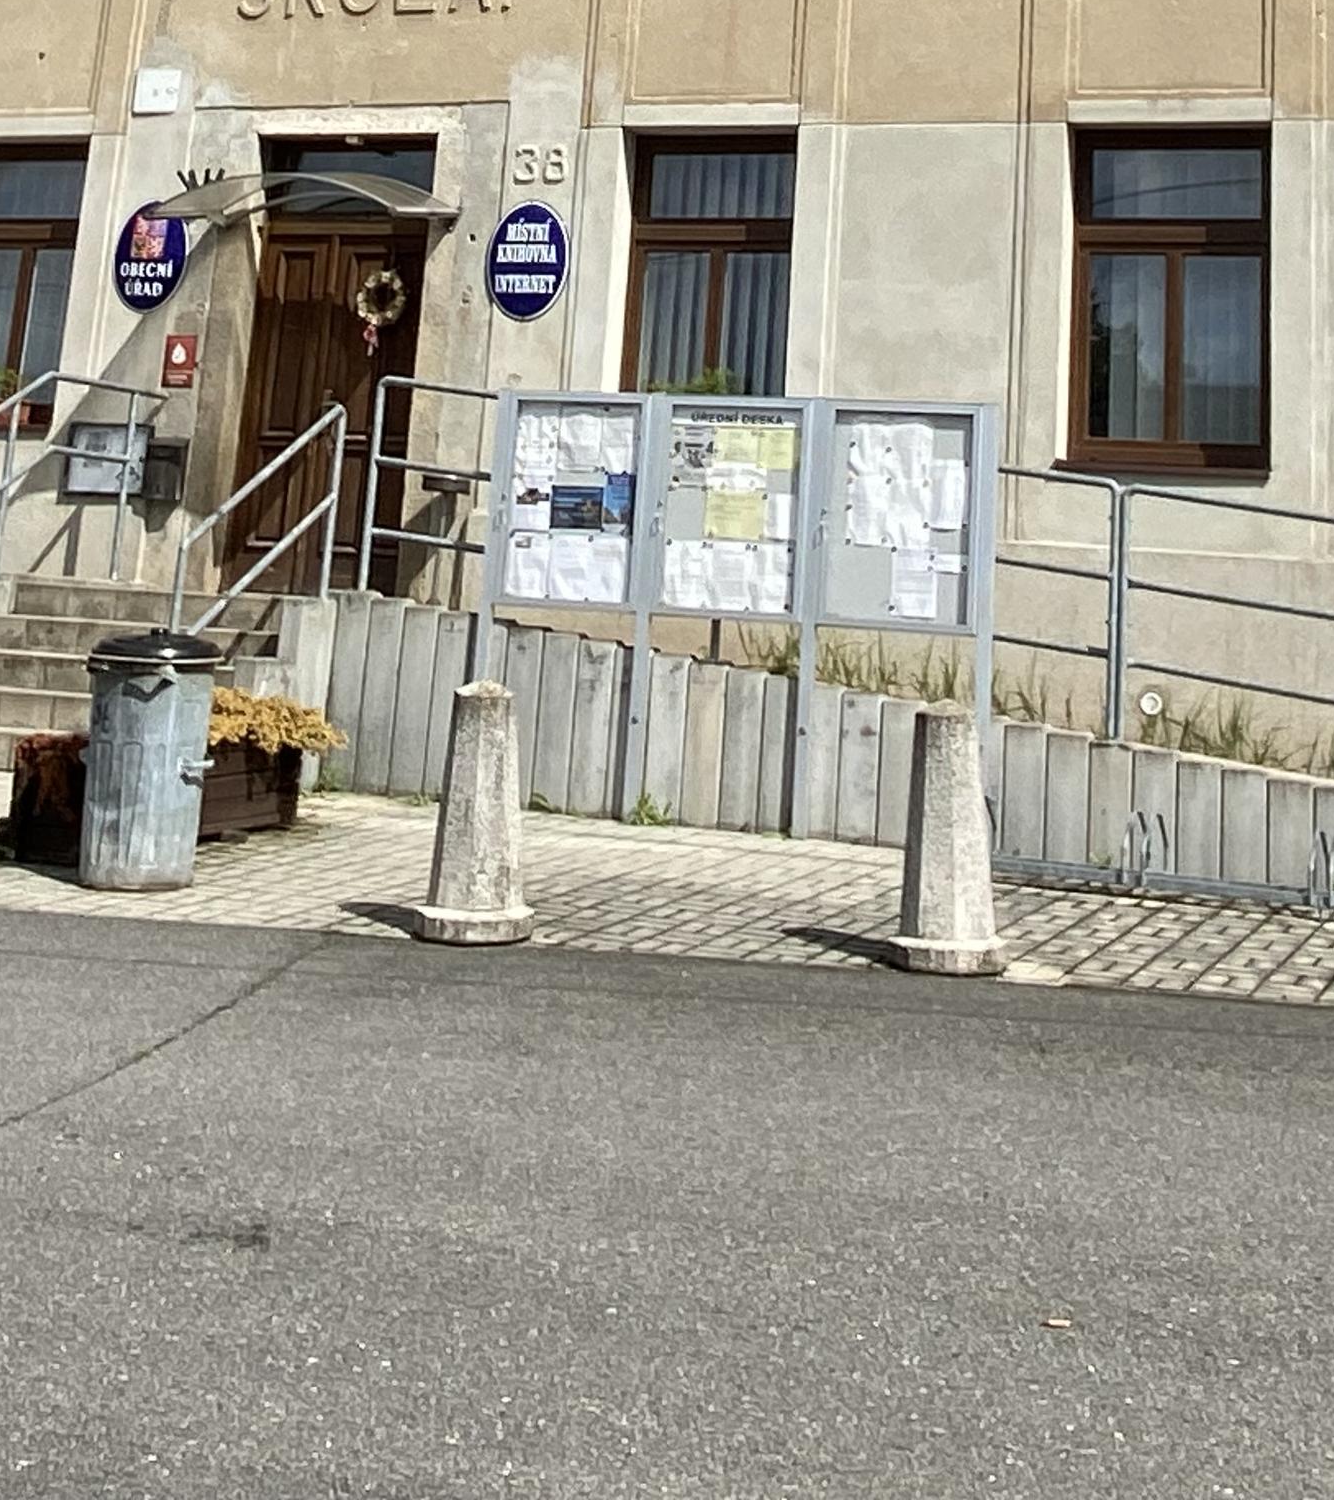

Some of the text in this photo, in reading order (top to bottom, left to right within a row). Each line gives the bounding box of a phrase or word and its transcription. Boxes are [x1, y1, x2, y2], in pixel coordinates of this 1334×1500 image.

[513, 144, 569, 185] 38
[505, 217, 553, 242] MÍSTNÍ
[496, 244, 557, 263] KNIHOVNA
[120, 260, 173, 278] OBECNÍ
[124, 278, 163, 296] ÚŘAD
[494, 274, 557, 293] INTERNET
